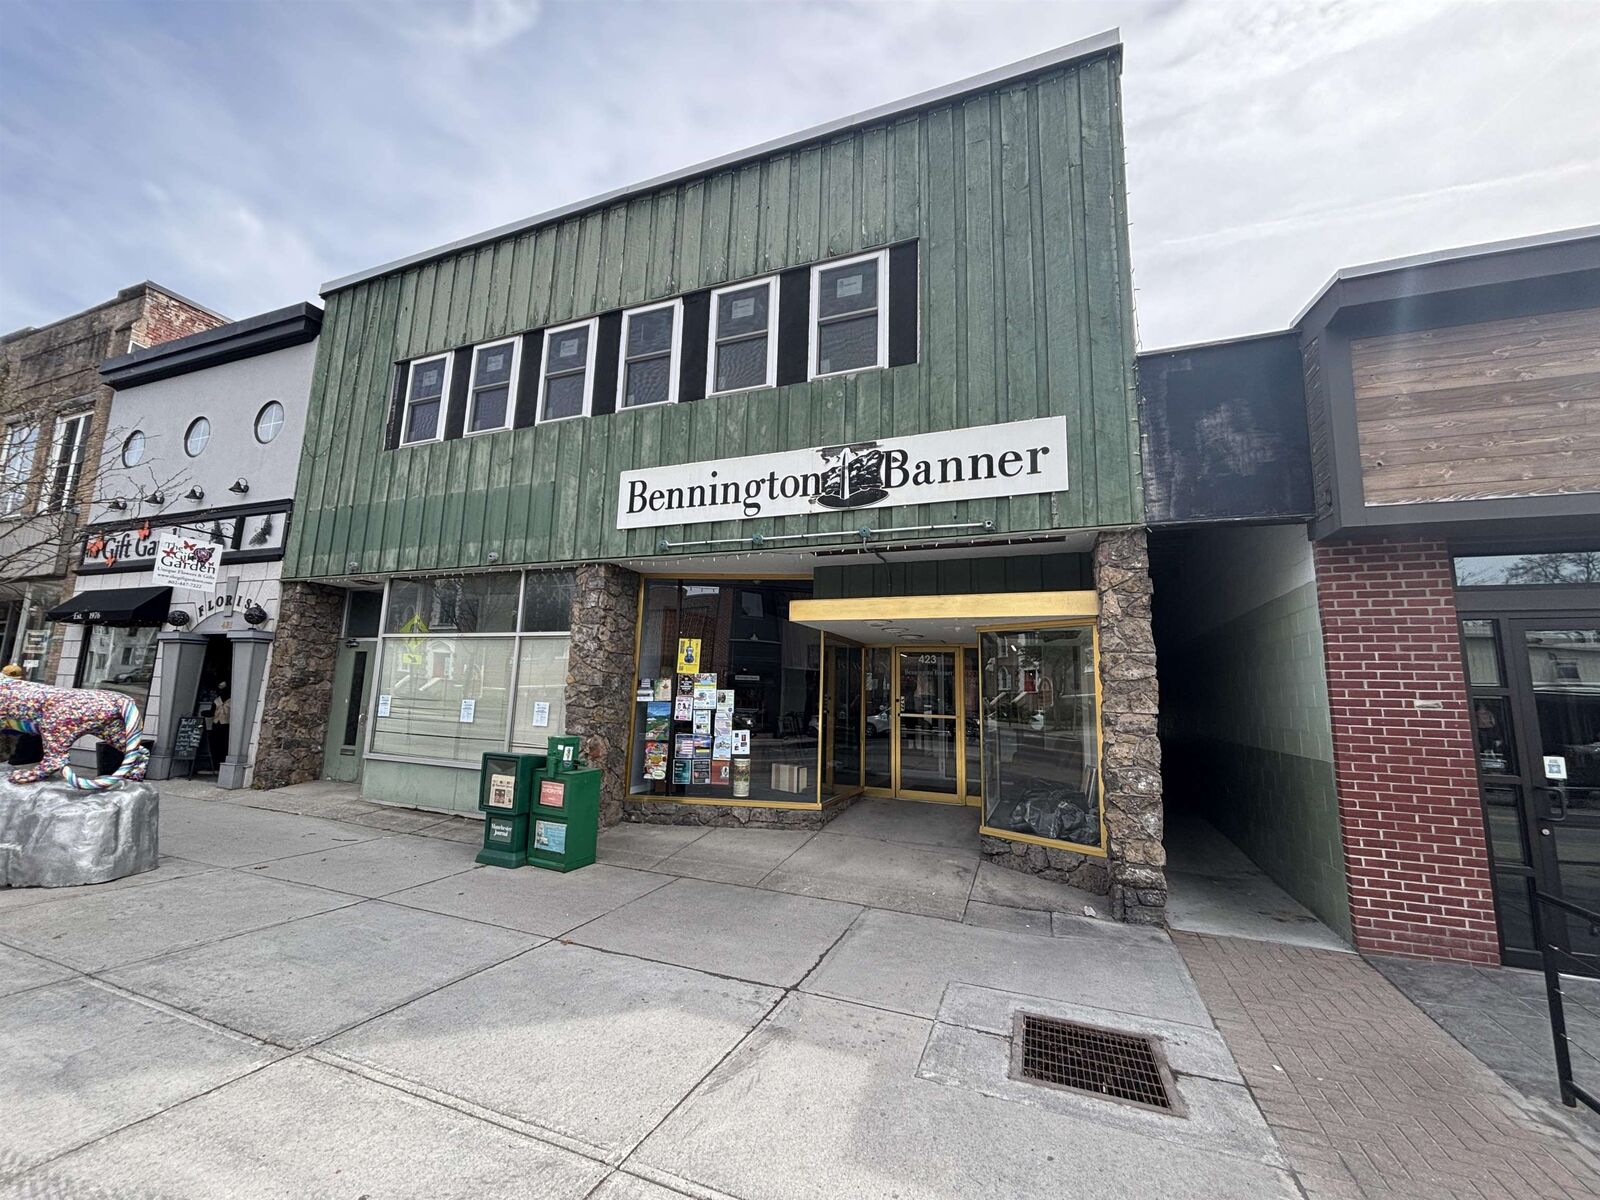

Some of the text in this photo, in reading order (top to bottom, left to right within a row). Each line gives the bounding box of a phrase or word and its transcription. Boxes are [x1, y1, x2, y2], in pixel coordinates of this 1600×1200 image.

[626, 446, 1050, 517] Bennington Banner
[103, 533, 132, 560] Gift
[165, 541, 183, 551] The
[161, 556, 216, 574] Garden
[918, 654, 937, 664] 423
